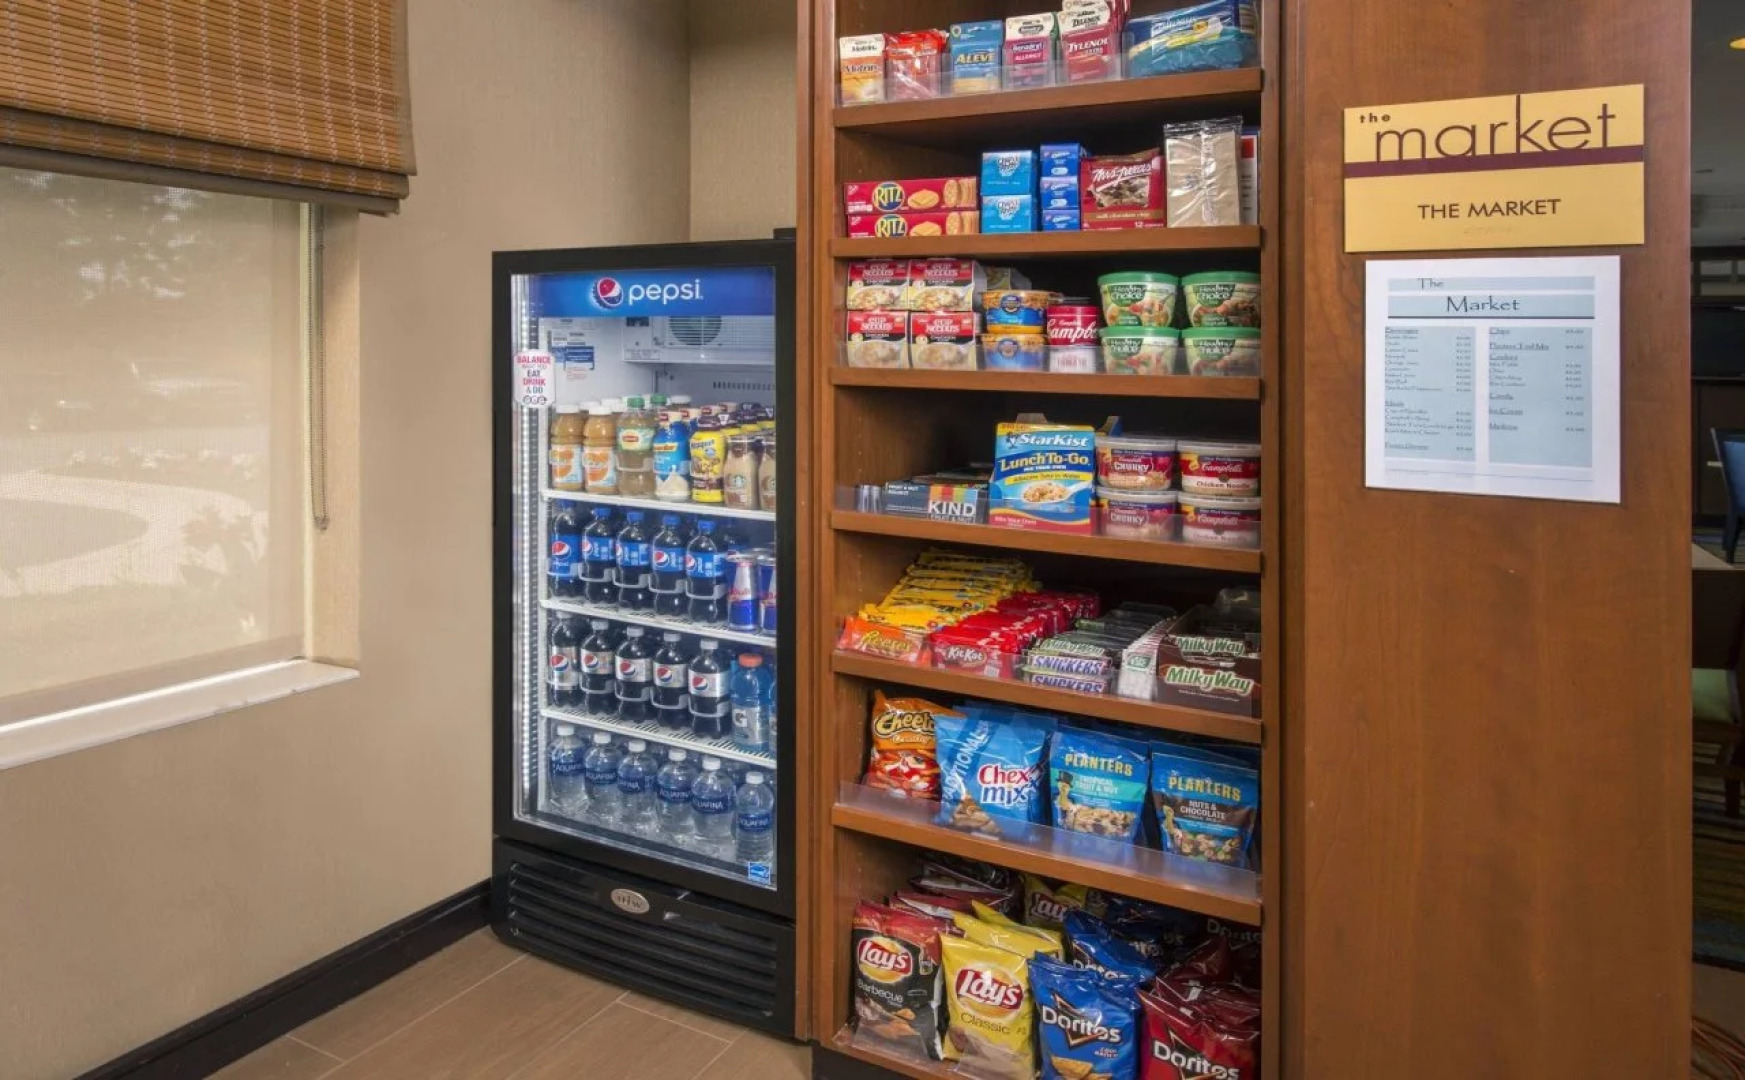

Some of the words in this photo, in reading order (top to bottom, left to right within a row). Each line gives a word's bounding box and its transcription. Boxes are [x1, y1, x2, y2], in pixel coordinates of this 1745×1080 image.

[955, 52, 995, 65] ALEVE
[1359, 112, 1391, 124] the
[1376, 94, 1616, 162] market
[874, 186, 904, 206] RITZ
[1418, 203, 1460, 219] THE
[1467, 198, 1562, 217] MARKET
[877, 219, 907, 237] RITZ
[1114, 283, 1146, 292] Healthy
[1200, 283, 1233, 292] Healthy
[1418, 277, 1444, 290] The
[629, 278, 700, 306] pepsi
[1111, 291, 1143, 300] Choice
[1197, 291, 1229, 300] Choice
[1446, 295, 1520, 313] Market
[860, 322, 893, 331] NOODLES
[926, 324, 959, 332] NOODLES
[517, 355, 551, 364] BALANCE
[523, 378, 546, 386] DRINK
[532, 386, 543, 394] DO
[1019, 433, 1089, 447] StarKist
[928, 501, 976, 517] KIND
[1034, 656, 1102, 676] SNICKERS
[1065, 754, 1133, 776] PLANTERS
[979, 764, 1031, 785] Chex
[660, 789, 689, 799] AQUAFIN
[1169, 776, 1241, 801] PLANTERS
[1189, 800, 1209, 811] NUTS
[1210, 803, 1217, 811] &
[1180, 806, 1226, 820] CHOCOLATE
[857, 981, 903, 1002] Barbecue
[961, 1013, 1010, 1036] Classic
[1042, 1007, 1122, 1042] Doritos
[1153, 1041, 1240, 1080] Doritos
